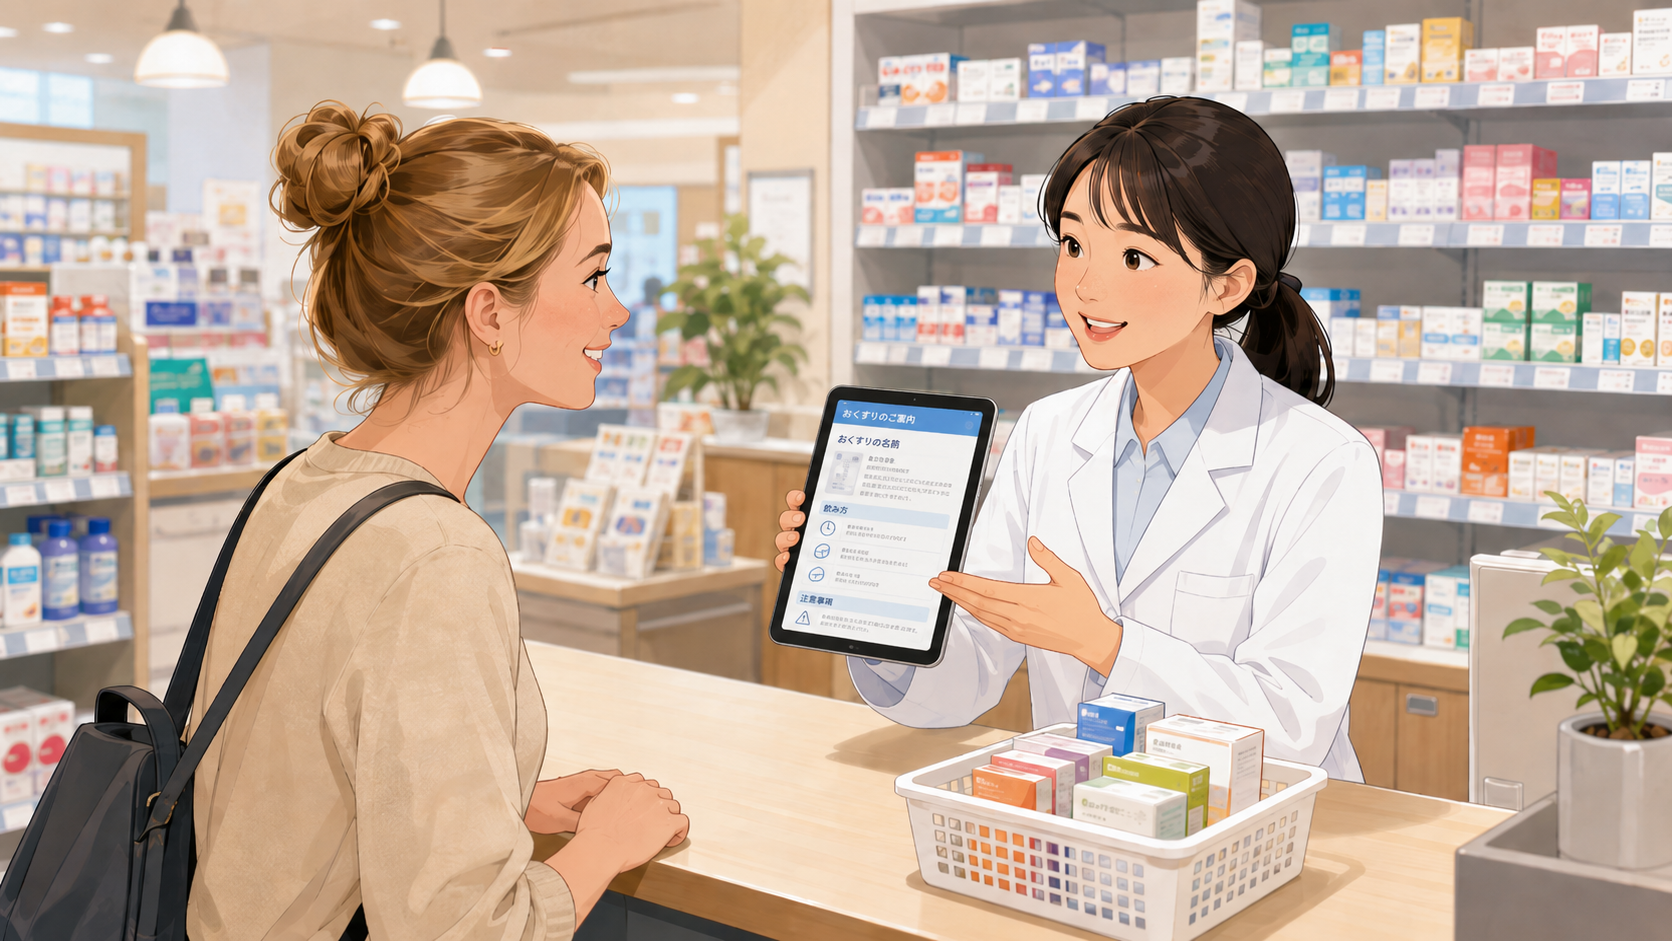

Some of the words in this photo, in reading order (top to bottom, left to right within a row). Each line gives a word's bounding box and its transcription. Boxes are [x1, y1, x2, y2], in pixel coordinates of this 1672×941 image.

[842, 409, 916, 425] おくすりのご案内
[837, 434, 900, 450] おくすりの名前
[823, 504, 848, 515] 飲み方
